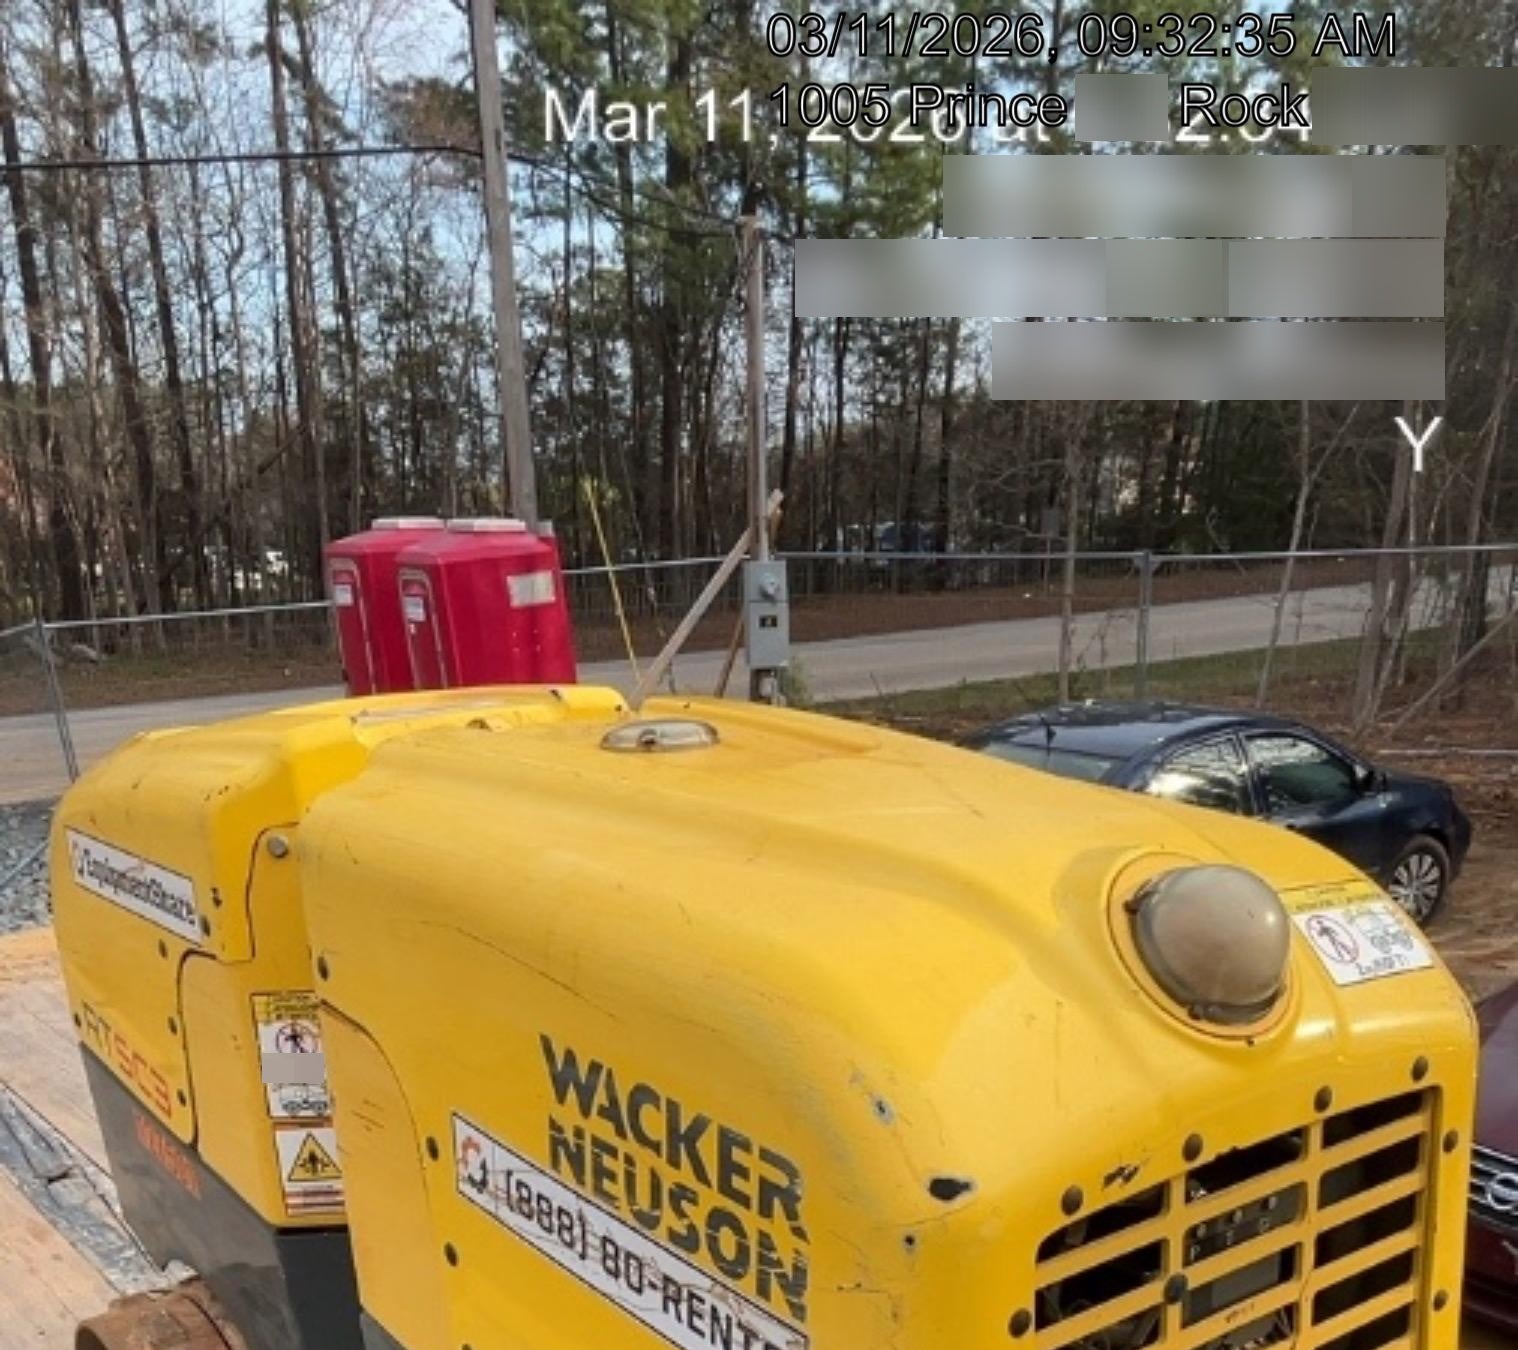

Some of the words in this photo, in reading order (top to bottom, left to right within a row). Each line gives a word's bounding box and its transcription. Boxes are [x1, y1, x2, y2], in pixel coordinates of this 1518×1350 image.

[505, 1169, 589, 1262] (888)
[539, 1032, 810, 1245] WACKER
[548, 1113, 808, 1323] NEUSON
